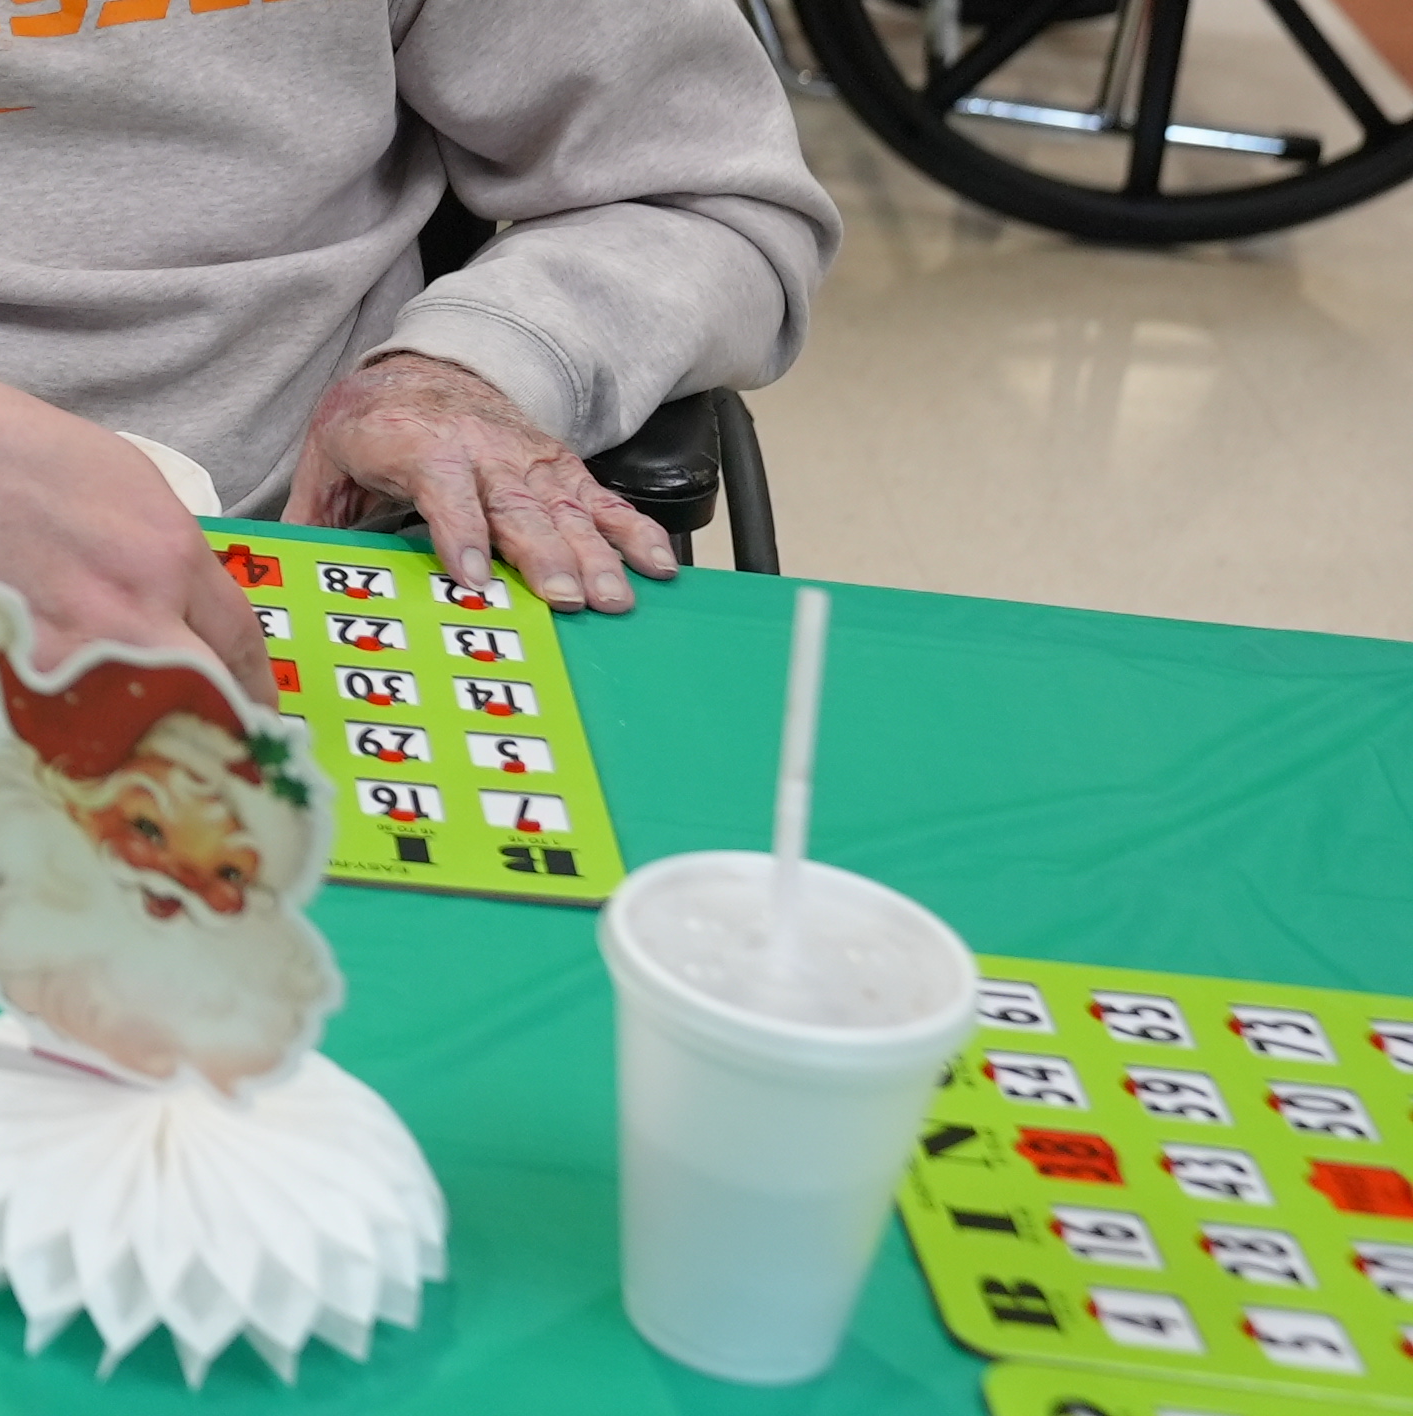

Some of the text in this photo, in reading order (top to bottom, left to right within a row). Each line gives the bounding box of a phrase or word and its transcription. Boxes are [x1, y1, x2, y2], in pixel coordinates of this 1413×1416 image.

[323, 567, 384, 597] 28
[333, 618, 394, 648] 22
[456, 631, 506, 659] 13
[345, 671, 523, 713] 14 30
[357, 728, 419, 761] 29
[372, 787, 430, 818] 16
[977, 991, 1041, 1025] 61
[1103, 1004, 1181, 1041] 65
[1242, 1021, 1324, 1057] 73
[995, 1065, 1077, 1104] 54
[1136, 1079, 1218, 1119] 59
[1281, 1095, 1369, 1140] 50
[1174, 1158, 1254, 1198] 43
[1064, 1222, 1149, 1260] 16
[1103, 1311, 1180, 1334] 4
[1256, 1335, 1341, 1354] 5
